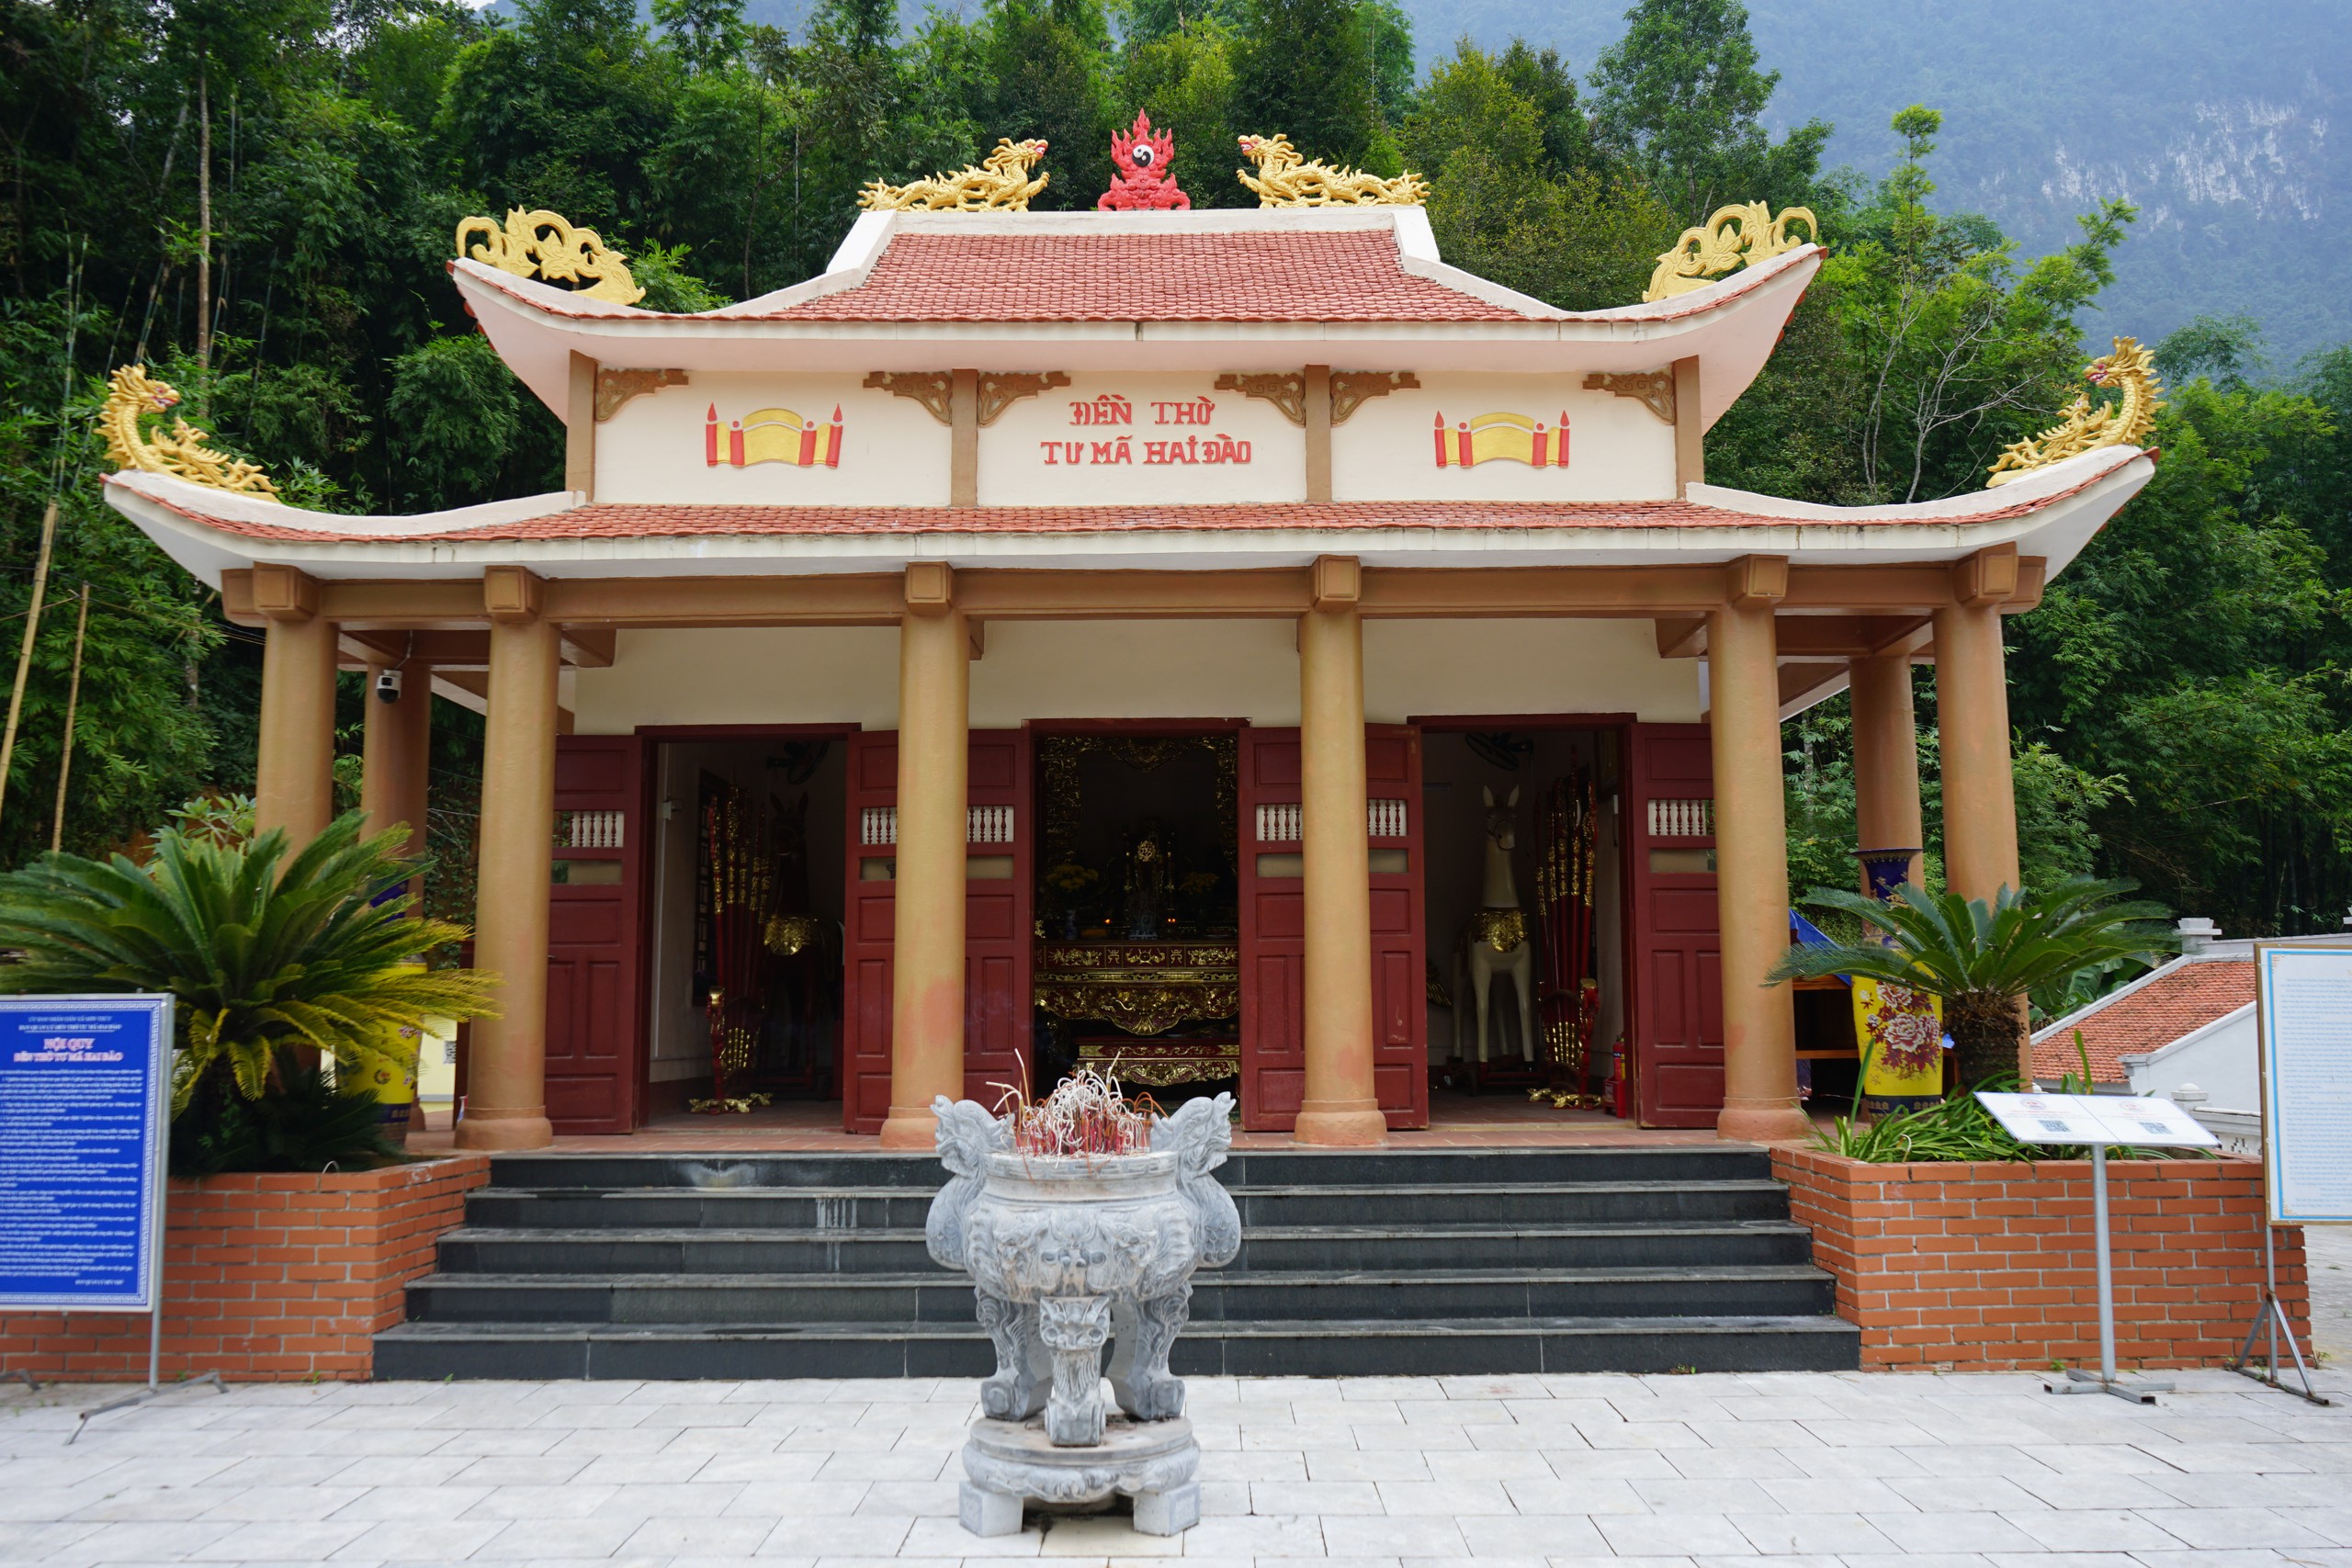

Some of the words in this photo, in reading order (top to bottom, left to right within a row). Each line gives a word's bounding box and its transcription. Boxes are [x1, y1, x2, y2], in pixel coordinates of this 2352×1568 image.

[1069, 394, 1133, 425] ĐỀN
[1150, 396, 1216, 425] THỜ
[1040, 442, 1084, 465] TƯ
[1090, 435, 1133, 465] MÃ
[1143, 434, 1200, 465] HAI
[1202, 434, 1251, 464] ĐÀO
